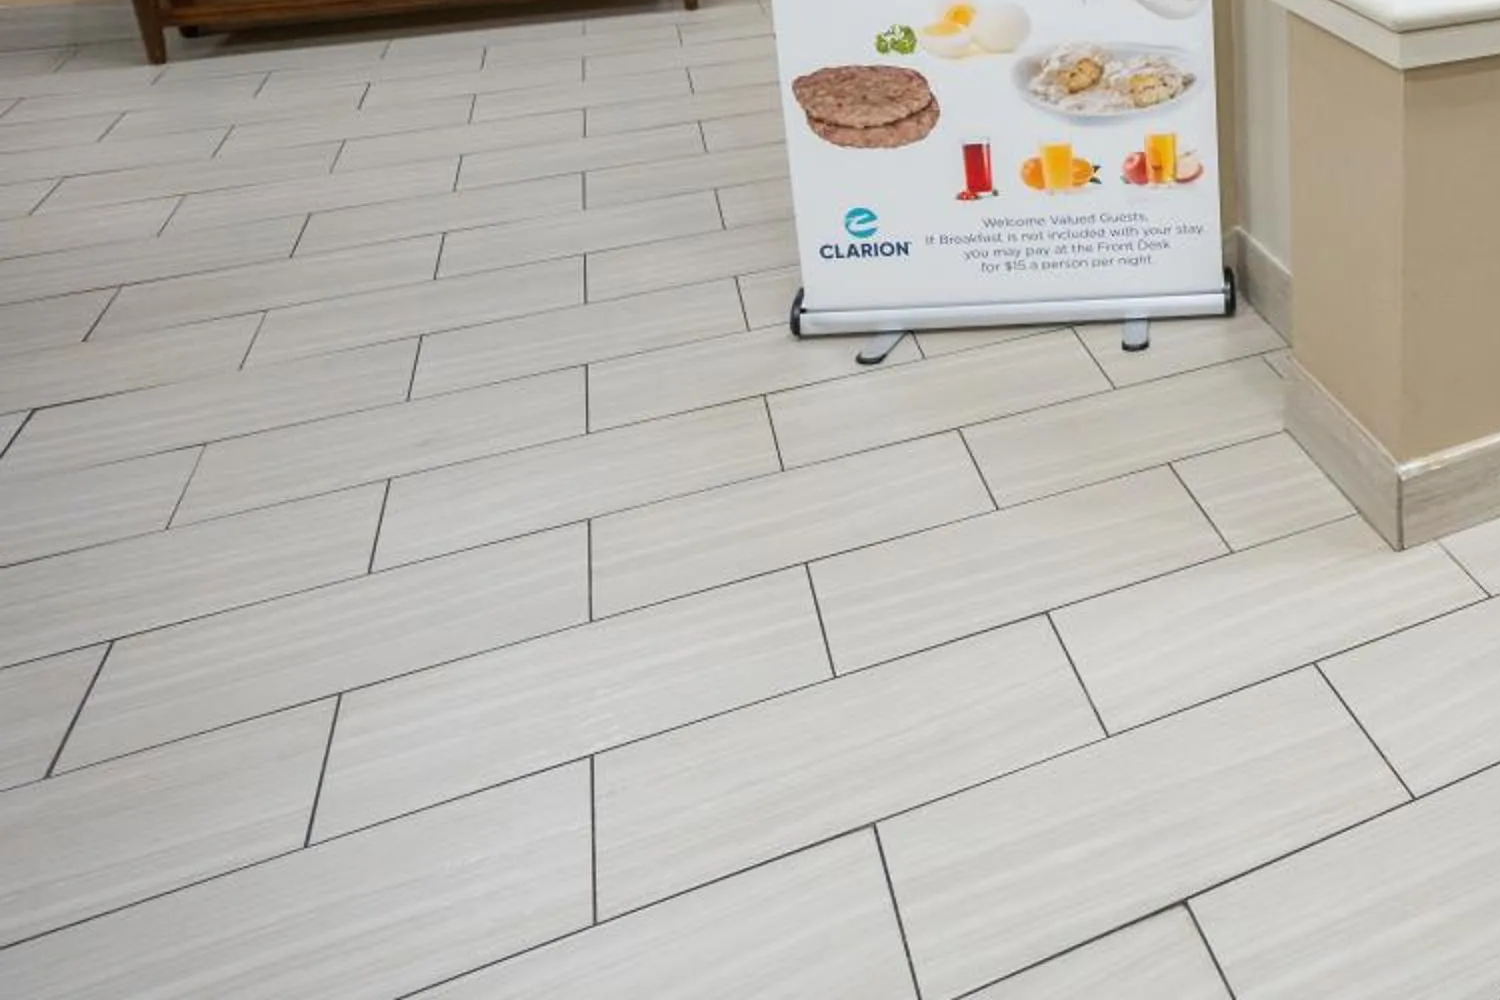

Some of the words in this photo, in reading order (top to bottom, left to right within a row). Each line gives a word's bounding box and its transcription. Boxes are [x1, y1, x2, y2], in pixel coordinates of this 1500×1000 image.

[982, 217, 1045, 228] Welcome
[1050, 214, 1096, 225] Valued
[939, 233, 1003, 245] Breakfast
[1007, 233, 1018, 243] is
[1021, 231, 1044, 241] not
[1047, 228, 1106, 240] included
[1109, 226, 1139, 237] with
[1142, 225, 1172, 238] your
[819, 242, 911, 259] CLARION
[964, 249, 989, 260] you
[993, 248, 1021, 259] may
[1026, 247, 1050, 257] pay
[1054, 244, 1068, 255] at
[1071, 243, 1093, 253] the
[1097, 241, 1134, 252] Front
[1138, 239, 1170, 251] Desk
[981, 262, 1000, 273] for
[1029, 261, 1038, 271] a
[1041, 260, 1089, 270] person
[1091, 258, 1114, 268] per
